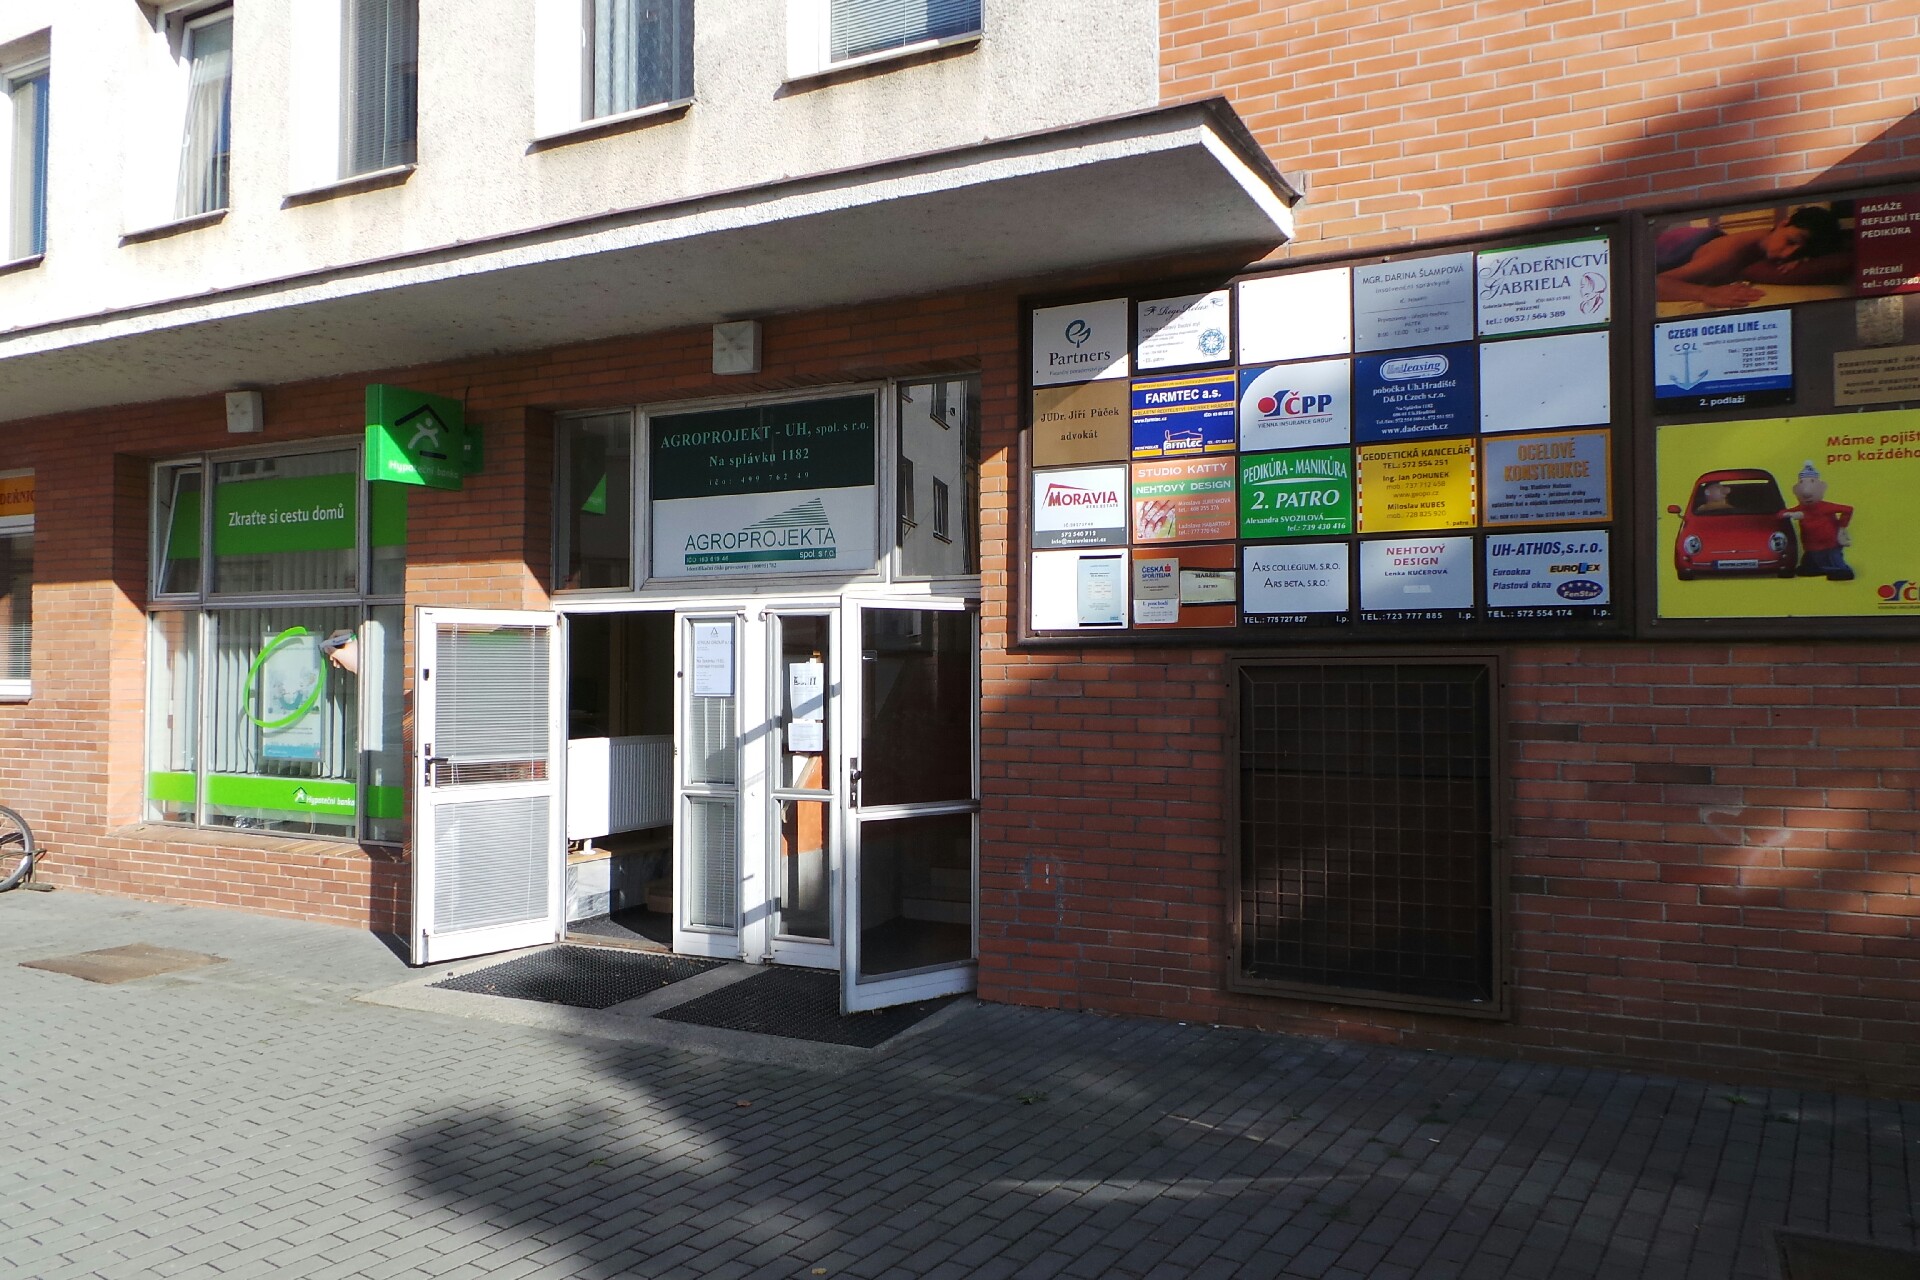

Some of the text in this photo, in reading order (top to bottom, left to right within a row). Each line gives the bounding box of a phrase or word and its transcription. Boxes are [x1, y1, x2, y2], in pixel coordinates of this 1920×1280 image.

[1862, 202, 1902, 213] MASÁŽE
[1862, 212, 1908, 226] REFLEXNÍ
[1862, 227, 1911, 238] PEDIKÚRA
[1479, 249, 1609, 279] KADEŘNICTVÍ
[1362, 263, 1464, 284] MGR. DARINA ŠLAMPOVÁ
[1480, 276, 1571, 300] GABRIELA
[1504, 316, 1525, 324] 0632
[1668, 328, 1698, 340] CZECH
[1701, 324, 1734, 336] OCEAN
[1737, 321, 1759, 332] LINE
[1049, 351, 1111, 366] Partners
[1146, 389, 1222, 404] FARMTEC a.s.
[1285, 391, 1332, 415] ČPP
[1405, 393, 1426, 401] Czech
[1710, 395, 1745, 406] podlaží
[1041, 413, 1066, 422] JUDr.
[1069, 409, 1085, 420] Jiří
[1382, 422, 1448, 434] www.dadczech.cz
[660, 426, 771, 449] AGROPROJEKT
[785, 422, 812, 438] UH,
[816, 423, 840, 434] spol.
[852, 421, 869, 431] r.o.
[1061, 430, 1098, 441] advokát
[1827, 435, 1875, 446] Máme
[1164, 438, 1203, 450] farmtec
[1518, 437, 1576, 462] OCELOVÉ
[710, 448, 810, 468] Na splávku 1182
[1363, 444, 1471, 461] GEODETICKÁ KANCELÁŘ
[1827, 453, 1852, 465] pro
[1138, 462, 1228, 478] STUDIO KATTY
[1244, 458, 1288, 484] PEDIKÚRA
[1296, 456, 1347, 478] MANIKÚRA
[1412, 471, 1449, 480] POHUNEK
[1504, 460, 1590, 482] KONSTRUKCE
[1136, 480, 1231, 495] NEHTOVÝ DESIGN
[1048, 491, 1118, 507] MORAVIA
[1251, 492, 1269, 510] 2.
[1276, 490, 1340, 509] PATRO
[228, 503, 344, 527] Zkraťte si cestu domů
[1246, 513, 1324, 524] Alexandra SVOZILOVÁ
[685, 527, 836, 551] AGROPROJEKTA
[1386, 544, 1445, 556] NEHTOVÝ
[1492, 541, 1603, 556] UH-ATHOS,s.r.o.
[1394, 557, 1439, 566] DESIGN
[1550, 562, 1601, 574] EUROLEX
[1142, 565, 1164, 573] ČESKÁ
[1493, 568, 1531, 576] Eurookna
[1493, 581, 1551, 590] Plastová okna
[1564, 590, 1598, 598] FenStar
[337, 797, 355, 806] banka
